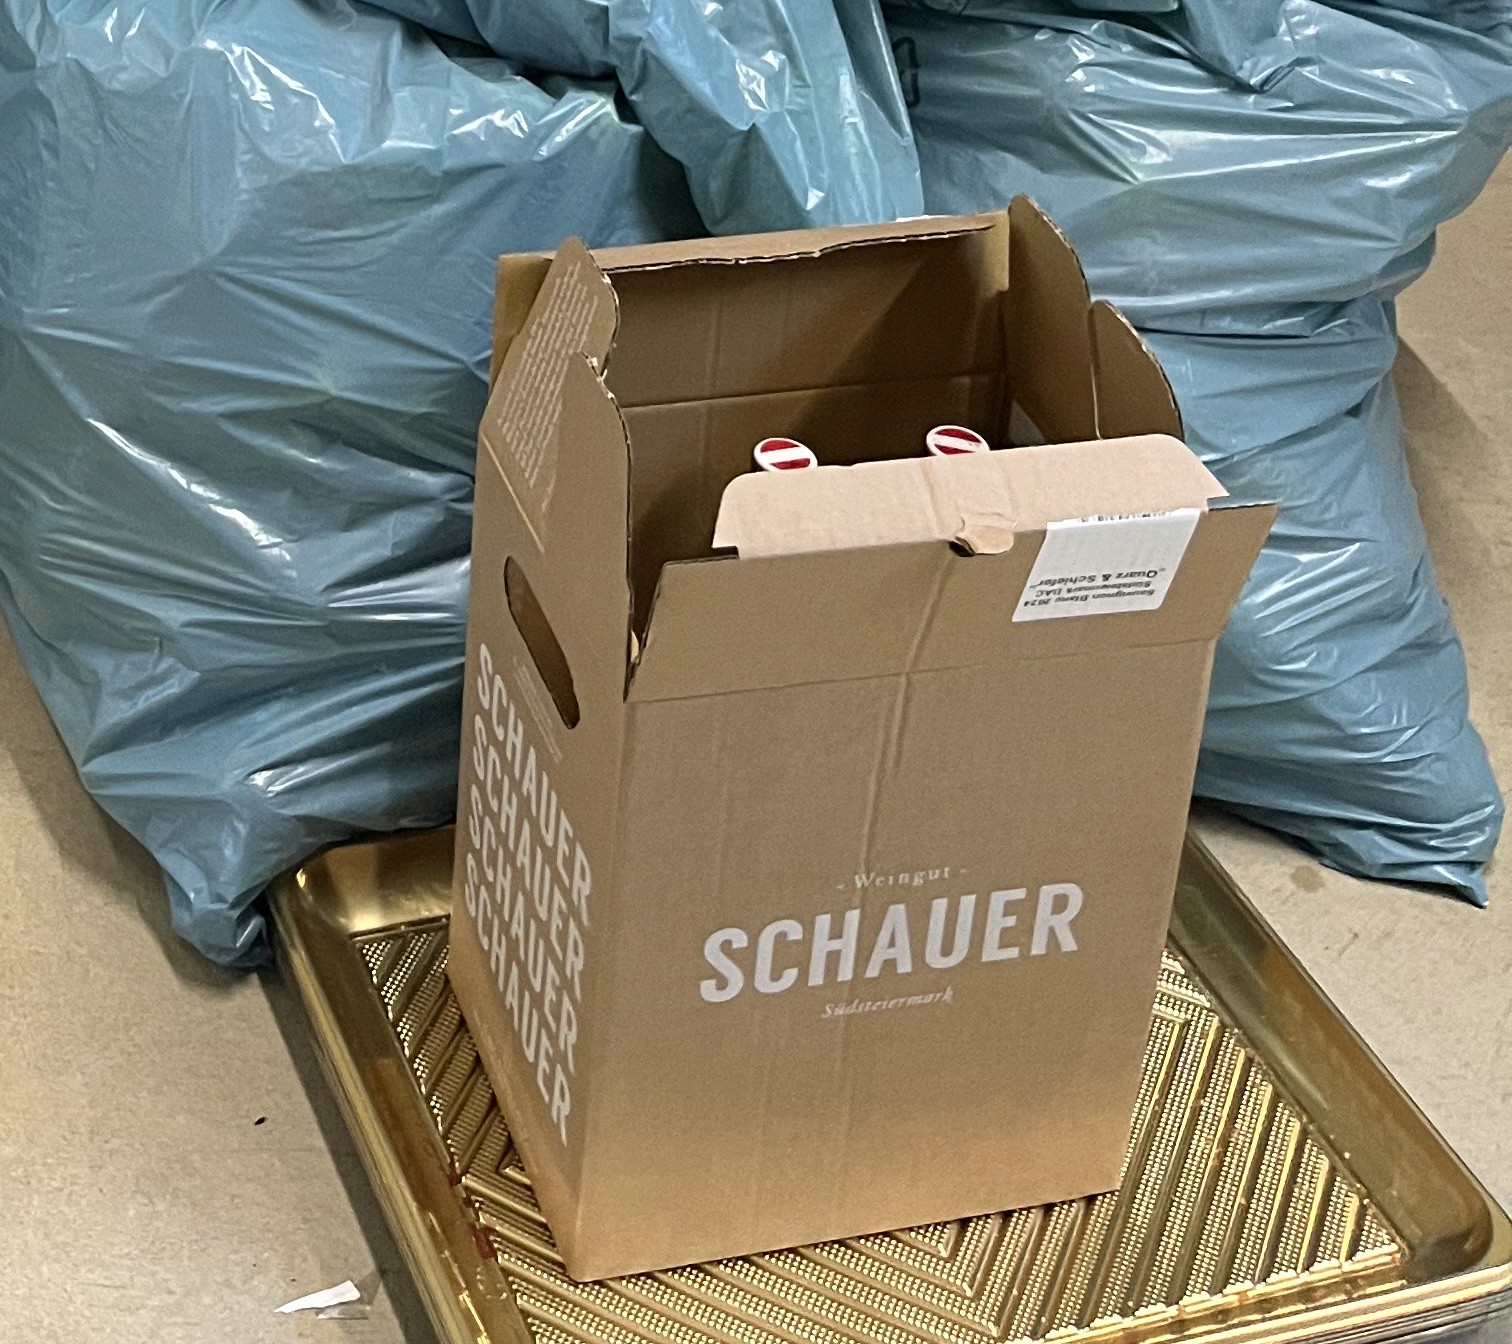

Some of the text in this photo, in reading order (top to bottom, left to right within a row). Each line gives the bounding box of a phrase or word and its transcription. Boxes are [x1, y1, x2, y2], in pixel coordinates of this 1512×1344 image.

[1102, 573, 1112, 583] &
[471, 714, 584, 1004] SCHAUER
[476, 643, 591, 927] SCHAUER
[854, 865, 950, 890] Weingut
[464, 852, 570, 1149] SCHAUER
[468, 783, 577, 1075] SCHAUER
[699, 882, 1084, 1003] SCHAUER
